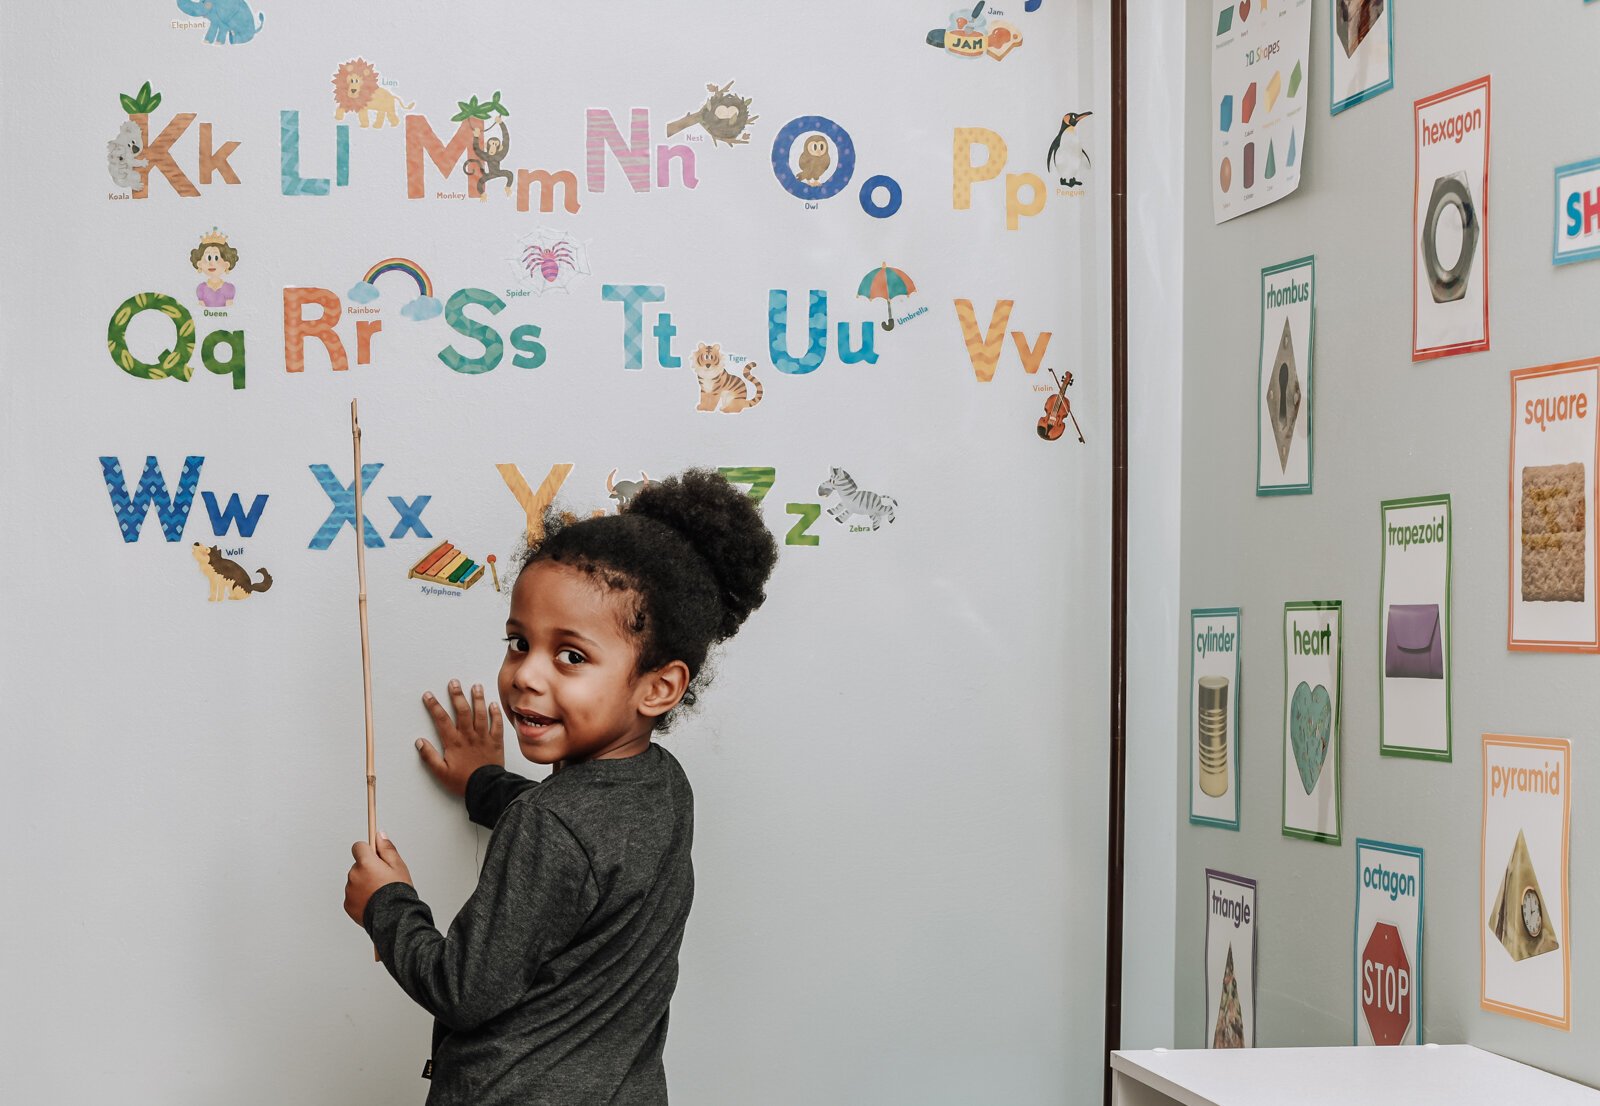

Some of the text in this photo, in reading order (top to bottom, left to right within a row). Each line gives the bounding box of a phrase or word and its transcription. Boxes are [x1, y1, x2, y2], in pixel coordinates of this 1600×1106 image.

[171, 20, 207, 31] Elephant
[988, 8, 1004, 16] Jam
[952, 38, 983, 50] JAM
[1256, 40, 1280, 63] Sapes
[381, 78, 398, 87] Lion
[686, 134, 704, 142] Nest
[1422, 108, 1482, 147] hexagon
[132, 113, 242, 199] Kk
[405, 114, 581, 214] Mm
[586, 108, 699, 193] Nn
[771, 115, 902, 218] Oo
[952, 127, 1047, 230] Pp
[1056, 188, 1085, 197] Penguin
[108, 192, 130, 201] Koala
[436, 191, 466, 201] Monkey
[804, 202, 819, 210] Owl
[347, 306, 381, 315] Rainbow
[506, 289, 531, 299] Spider
[1266, 279, 1309, 310] rhombus
[203, 310, 228, 318] Queen
[283, 287, 382, 373] Rr
[601, 284, 682, 371] Tt
[896, 305, 929, 327] Umbrella
[107, 292, 246, 389] Qq
[438, 288, 547, 375] Ss
[768, 289, 880, 375] Uu
[953, 299, 1053, 383] Vv
[728, 354, 748, 364] Tiger
[1032, 384, 1054, 393] Violin
[1524, 392, 1588, 432] square
[98, 456, 270, 543] Ww
[307, 463, 433, 551] Xx
[849, 524, 871, 533] Zebra
[1388, 515, 1445, 552] trapezoid
[225, 547, 244, 557] Wolf
[420, 585, 462, 598] Xylophone
[1196, 625, 1235, 659] cylinder
[1293, 621, 1332, 656] heart
[1491, 762, 1560, 799] pyramid
[1363, 864, 1416, 901] octagon
[1212, 889, 1251, 929] triangle
[1363, 959, 1410, 1015] STOP
